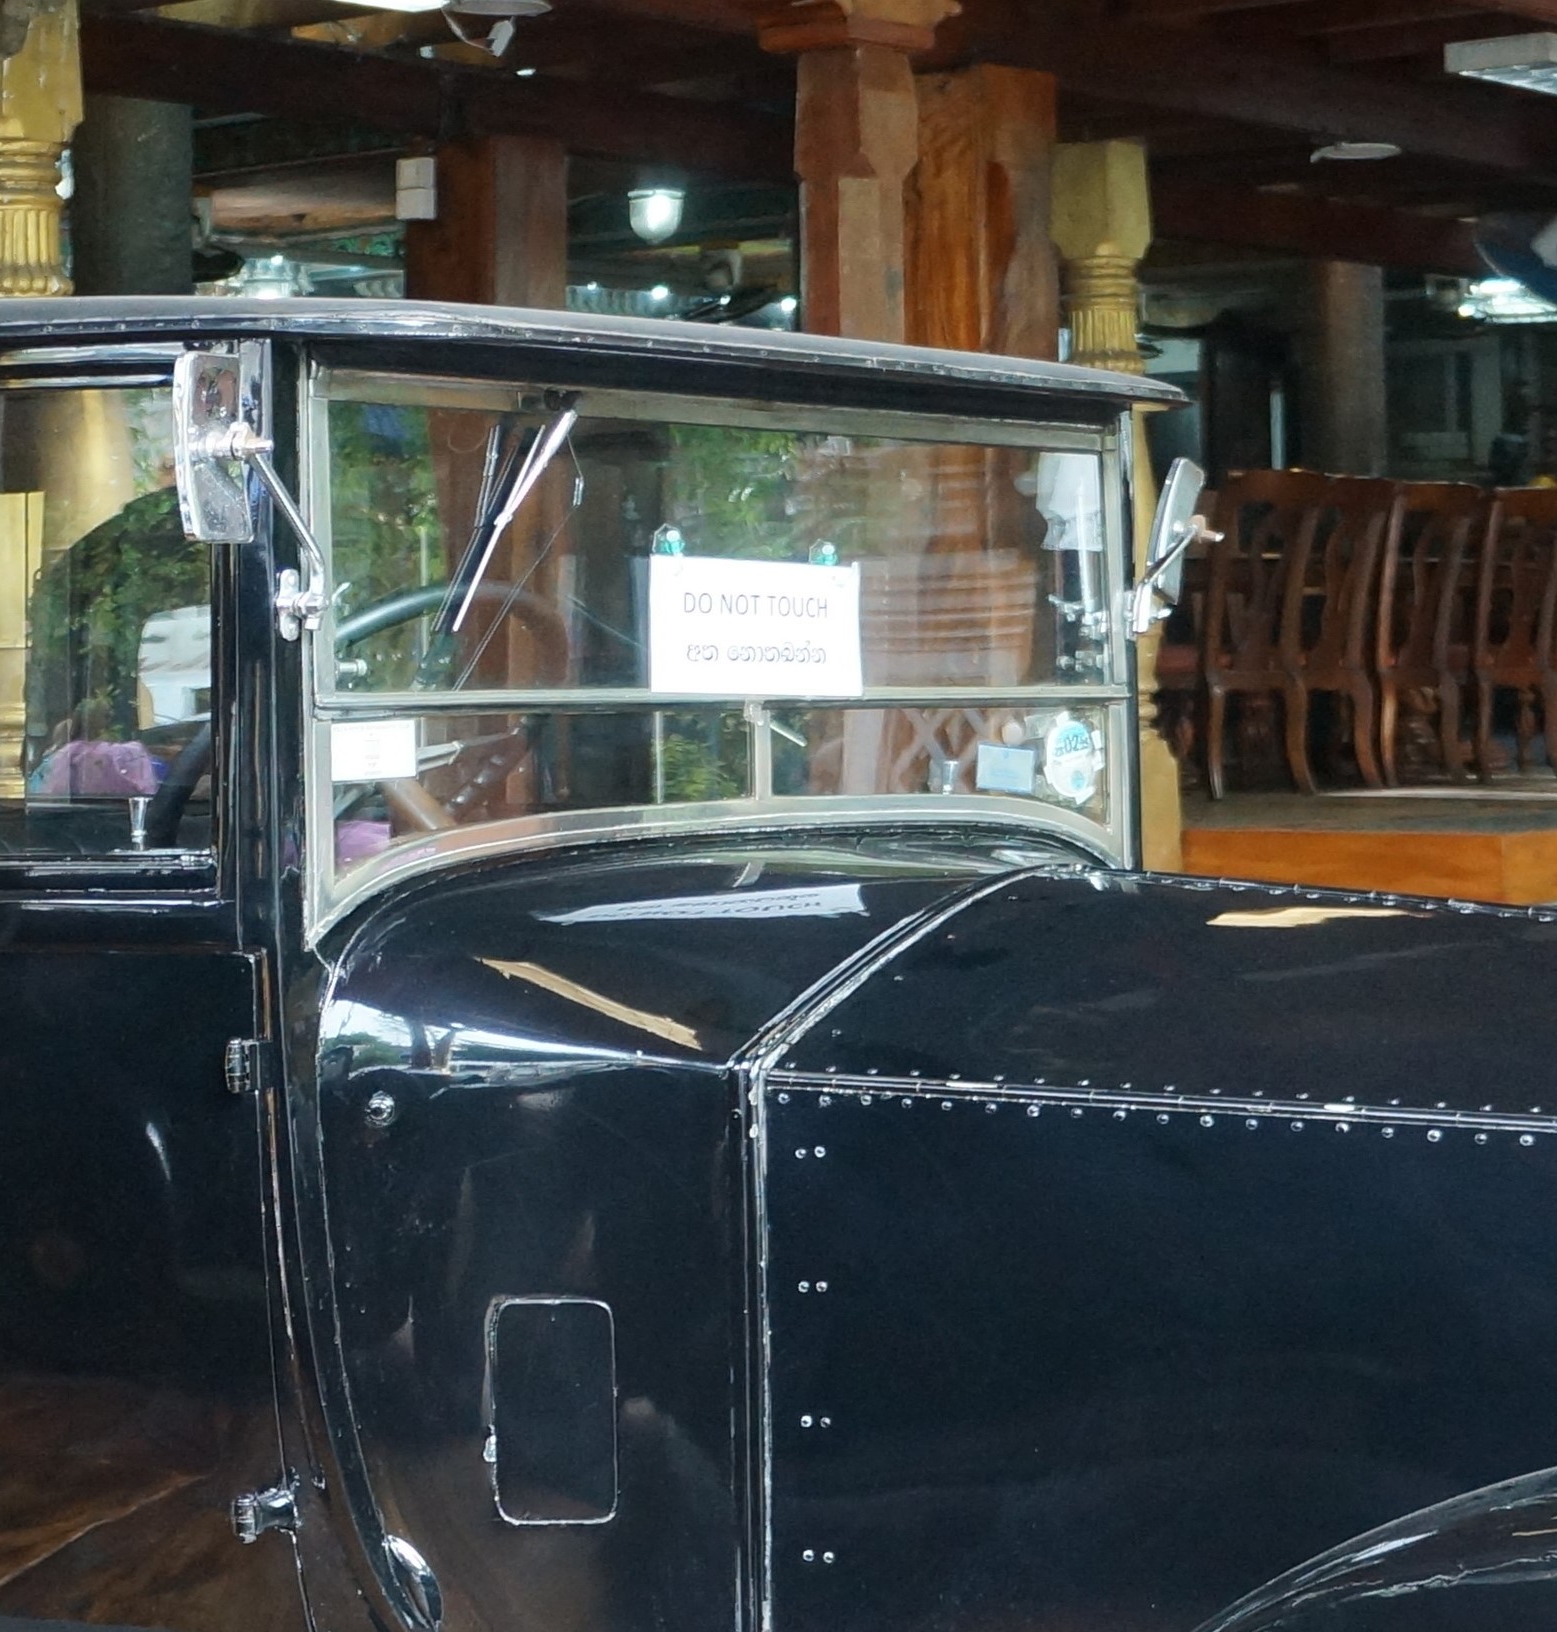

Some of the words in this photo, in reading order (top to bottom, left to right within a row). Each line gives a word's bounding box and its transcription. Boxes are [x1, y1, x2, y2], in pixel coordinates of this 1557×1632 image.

[684, 592, 713, 614] DO
[720, 594, 760, 616] NOT
[767, 595, 828, 618] TOUCH
